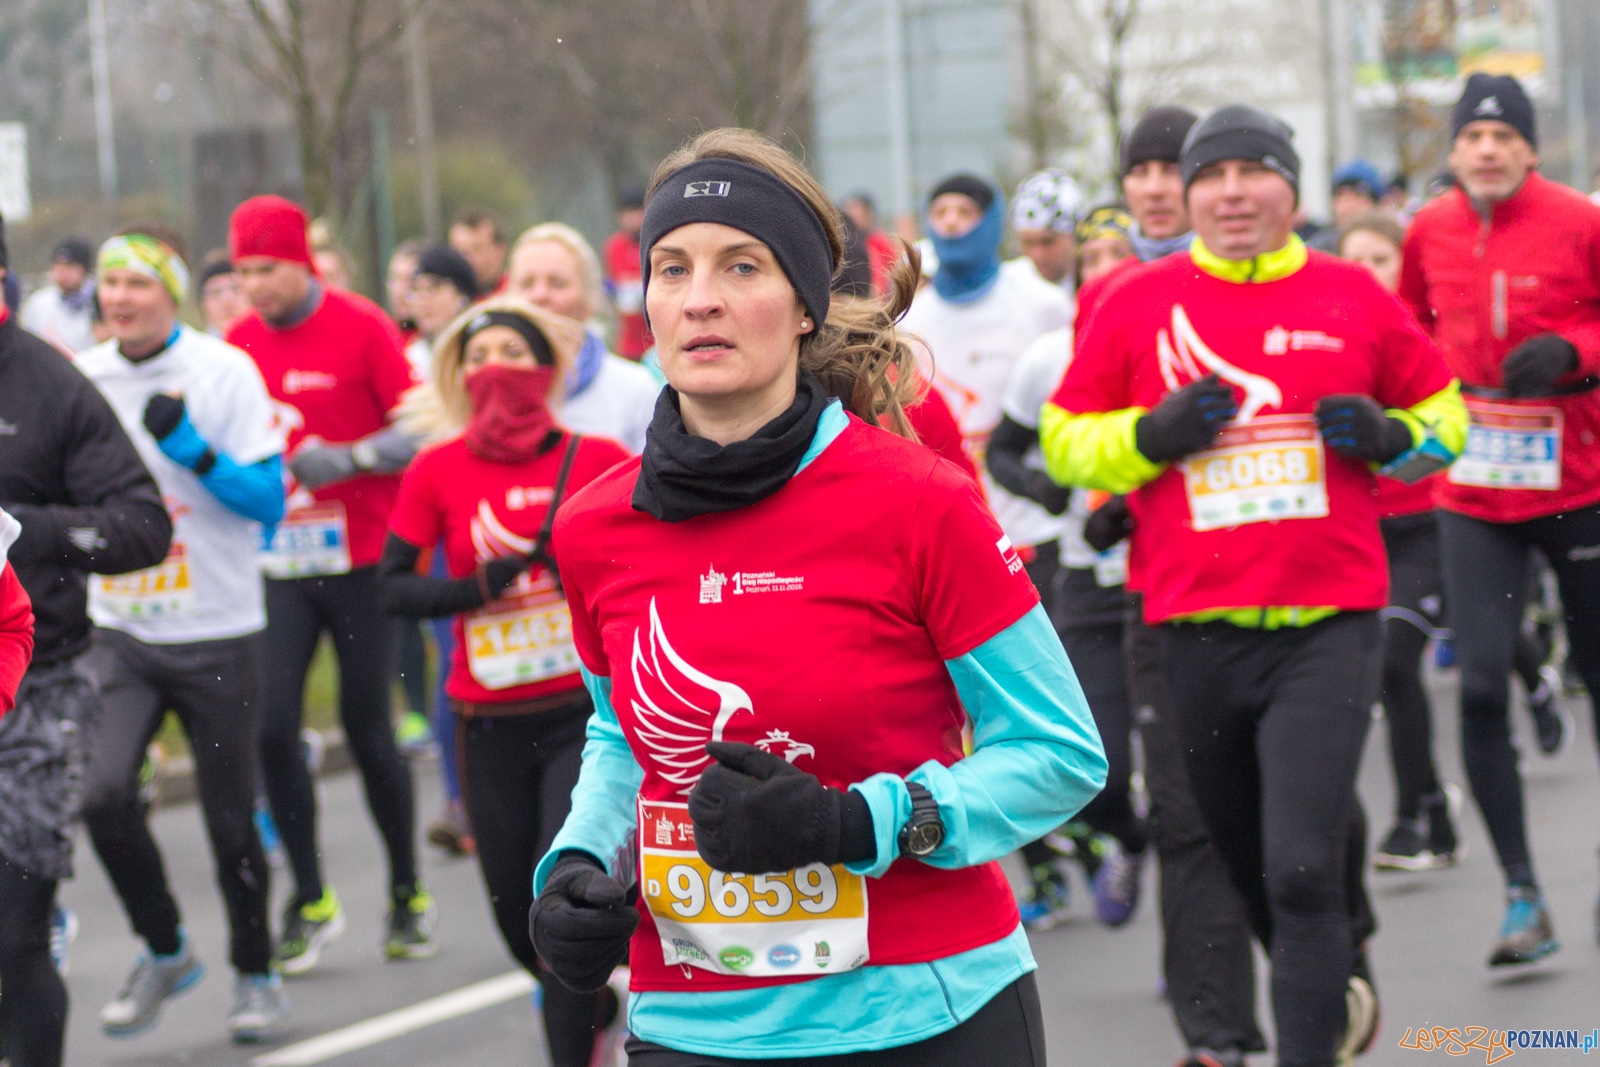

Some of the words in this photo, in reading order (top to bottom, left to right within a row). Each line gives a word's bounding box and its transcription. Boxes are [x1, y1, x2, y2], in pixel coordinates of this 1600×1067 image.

[1205, 450, 1309, 490] 6068
[732, 572, 744, 595] 1
[486, 612, 571, 653] 1462
[677, 822, 687, 841] 1
[648, 879, 661, 897] D
[667, 861, 838, 917] 9659
